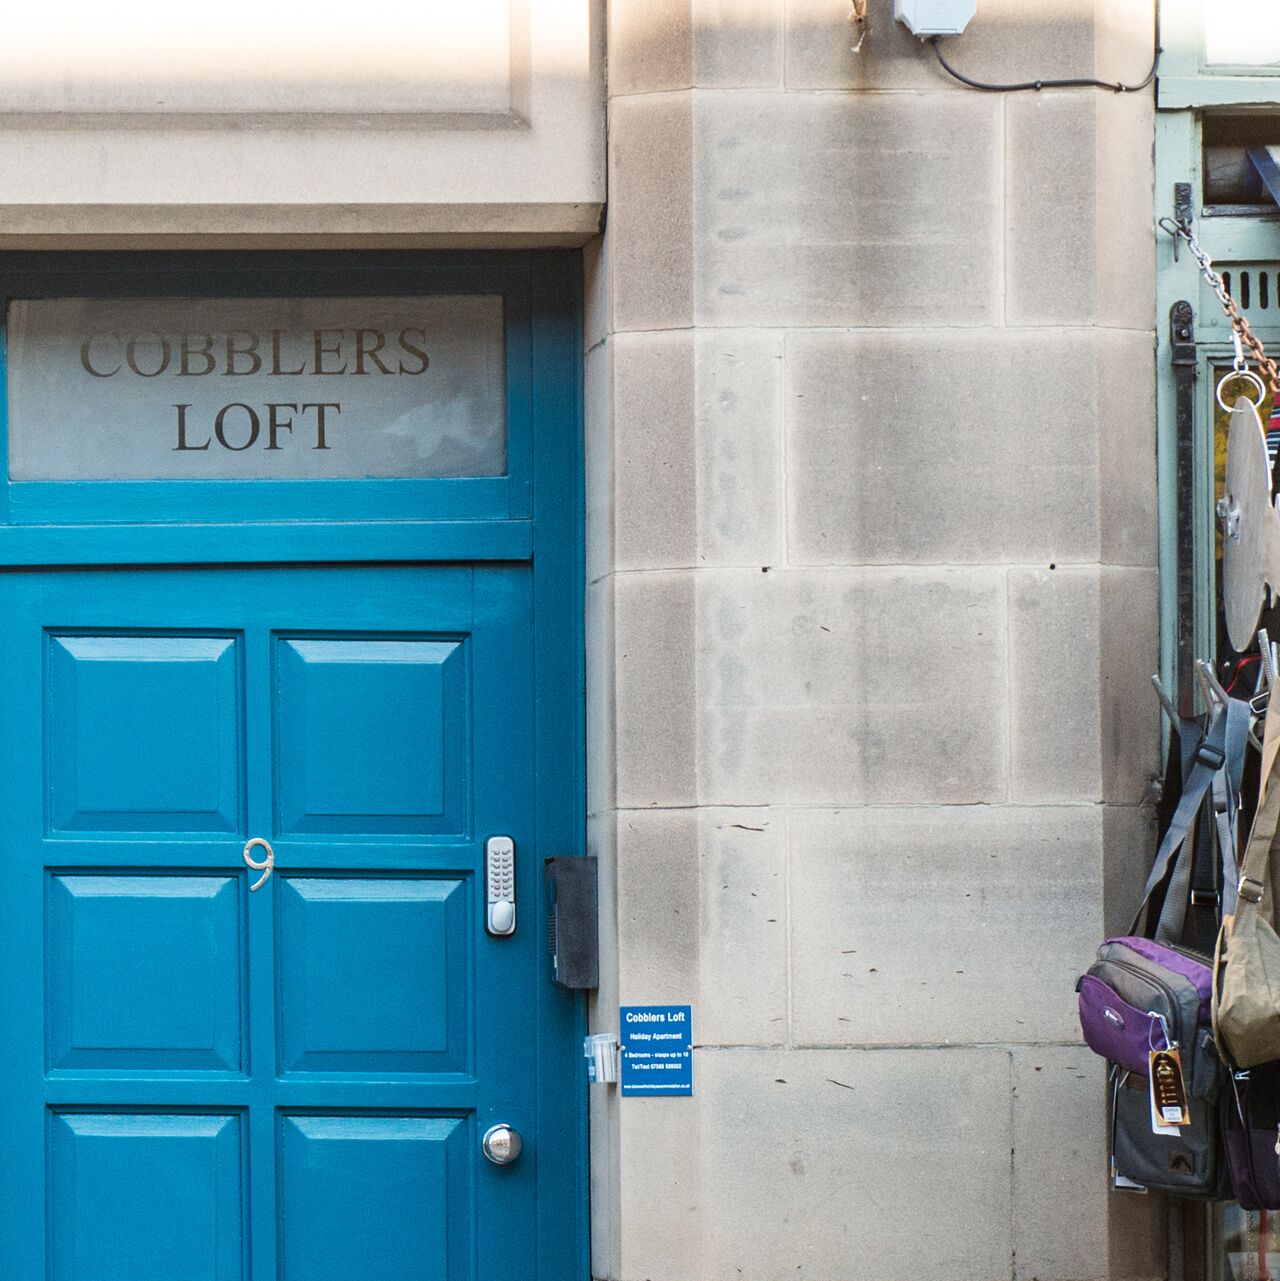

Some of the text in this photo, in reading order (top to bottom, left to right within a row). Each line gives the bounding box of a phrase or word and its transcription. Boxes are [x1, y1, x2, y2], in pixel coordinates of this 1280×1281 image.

[79, 326, 432, 378] COBBLERS
[171, 402, 342, 452] LOFT
[626, 1011, 685, 1022] Cobblers Loft
[630, 1032, 682, 1041] Holiday Apartment
